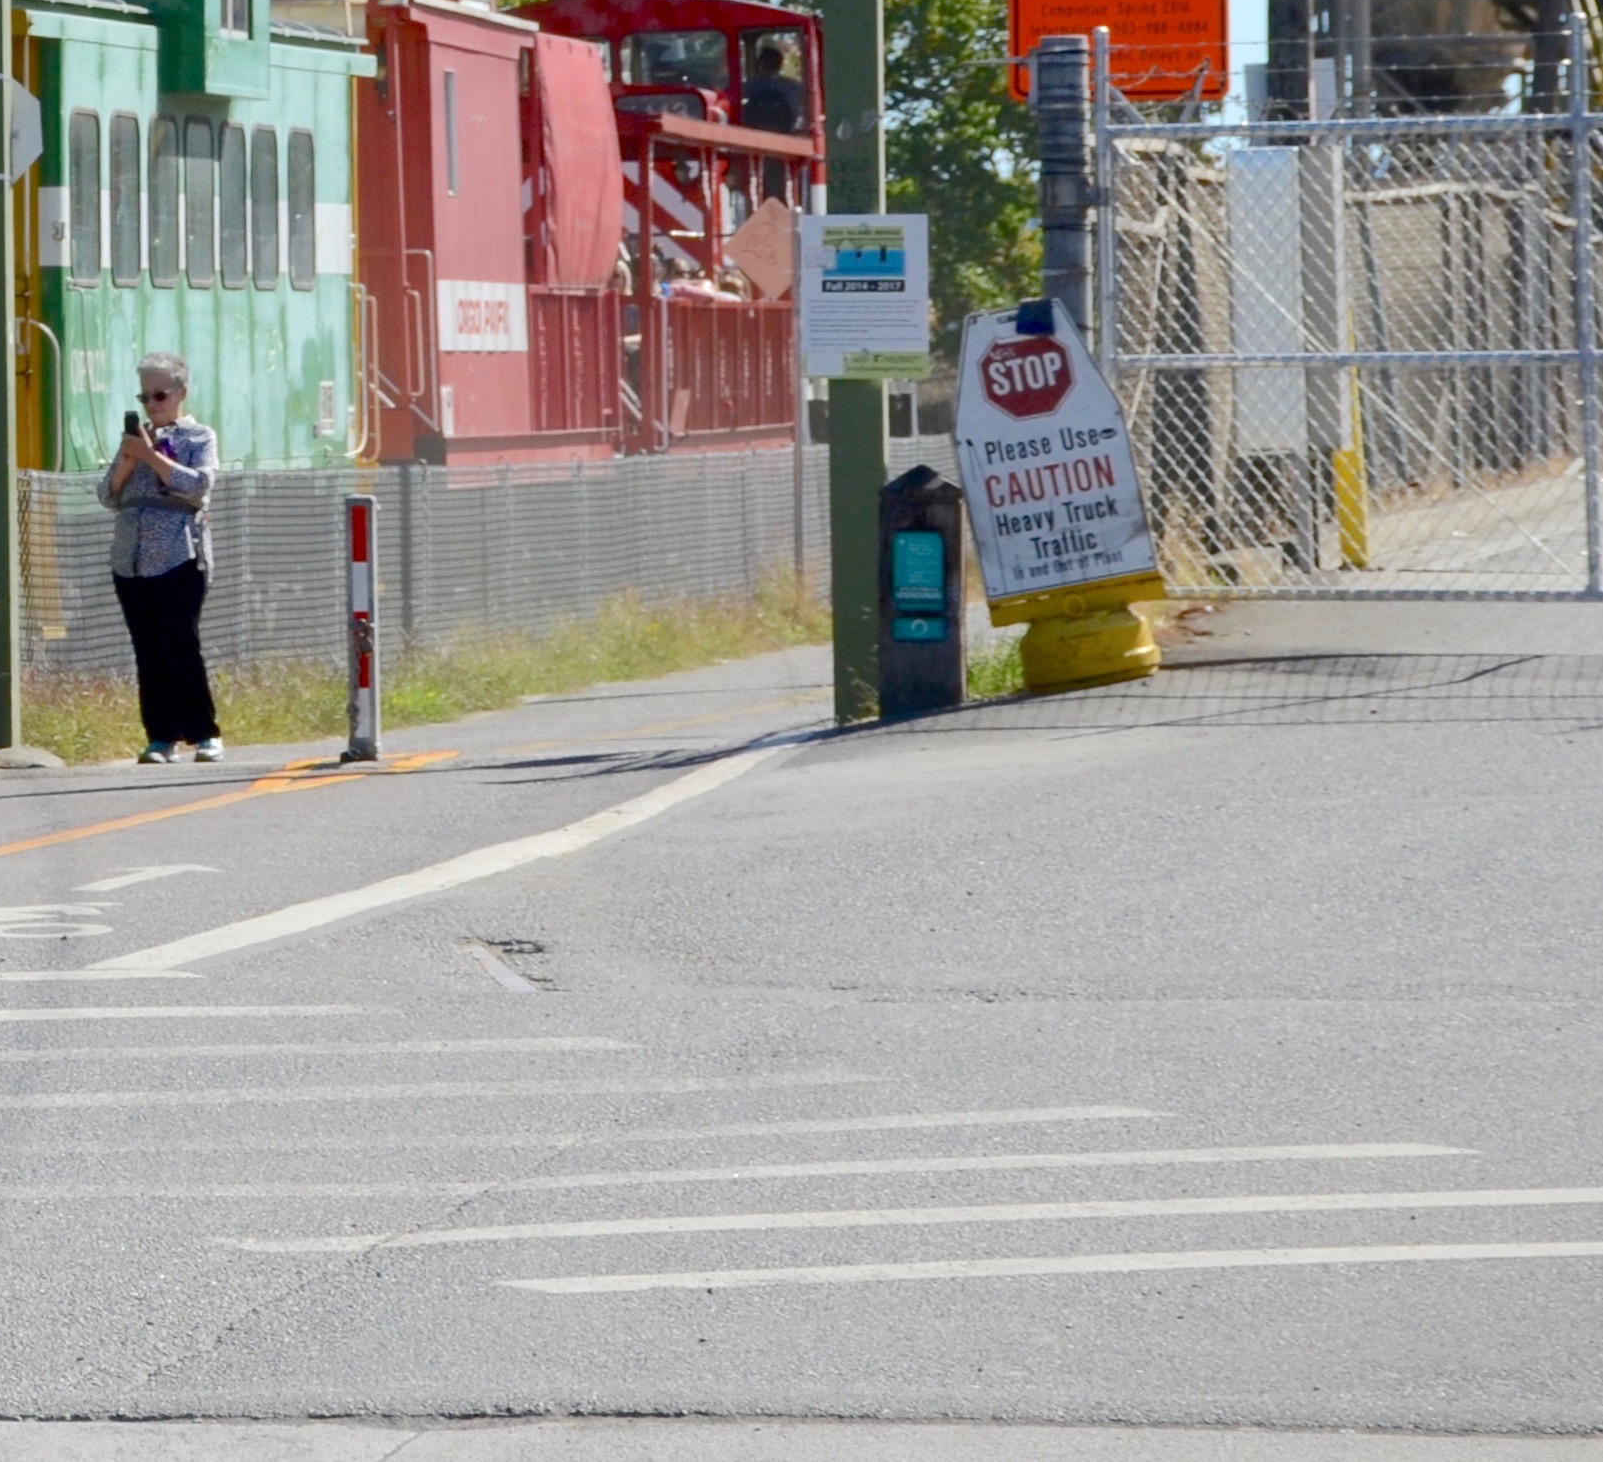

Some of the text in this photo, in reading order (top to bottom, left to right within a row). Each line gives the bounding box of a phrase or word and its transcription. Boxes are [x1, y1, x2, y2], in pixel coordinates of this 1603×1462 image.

[988, 351, 1063, 397] STOP
[984, 427, 1099, 465] Please Use
[983, 453, 1116, 509] CAUTION
[995, 494, 1120, 537] Heavy Truck
[1029, 531, 1098, 560] Traffic
